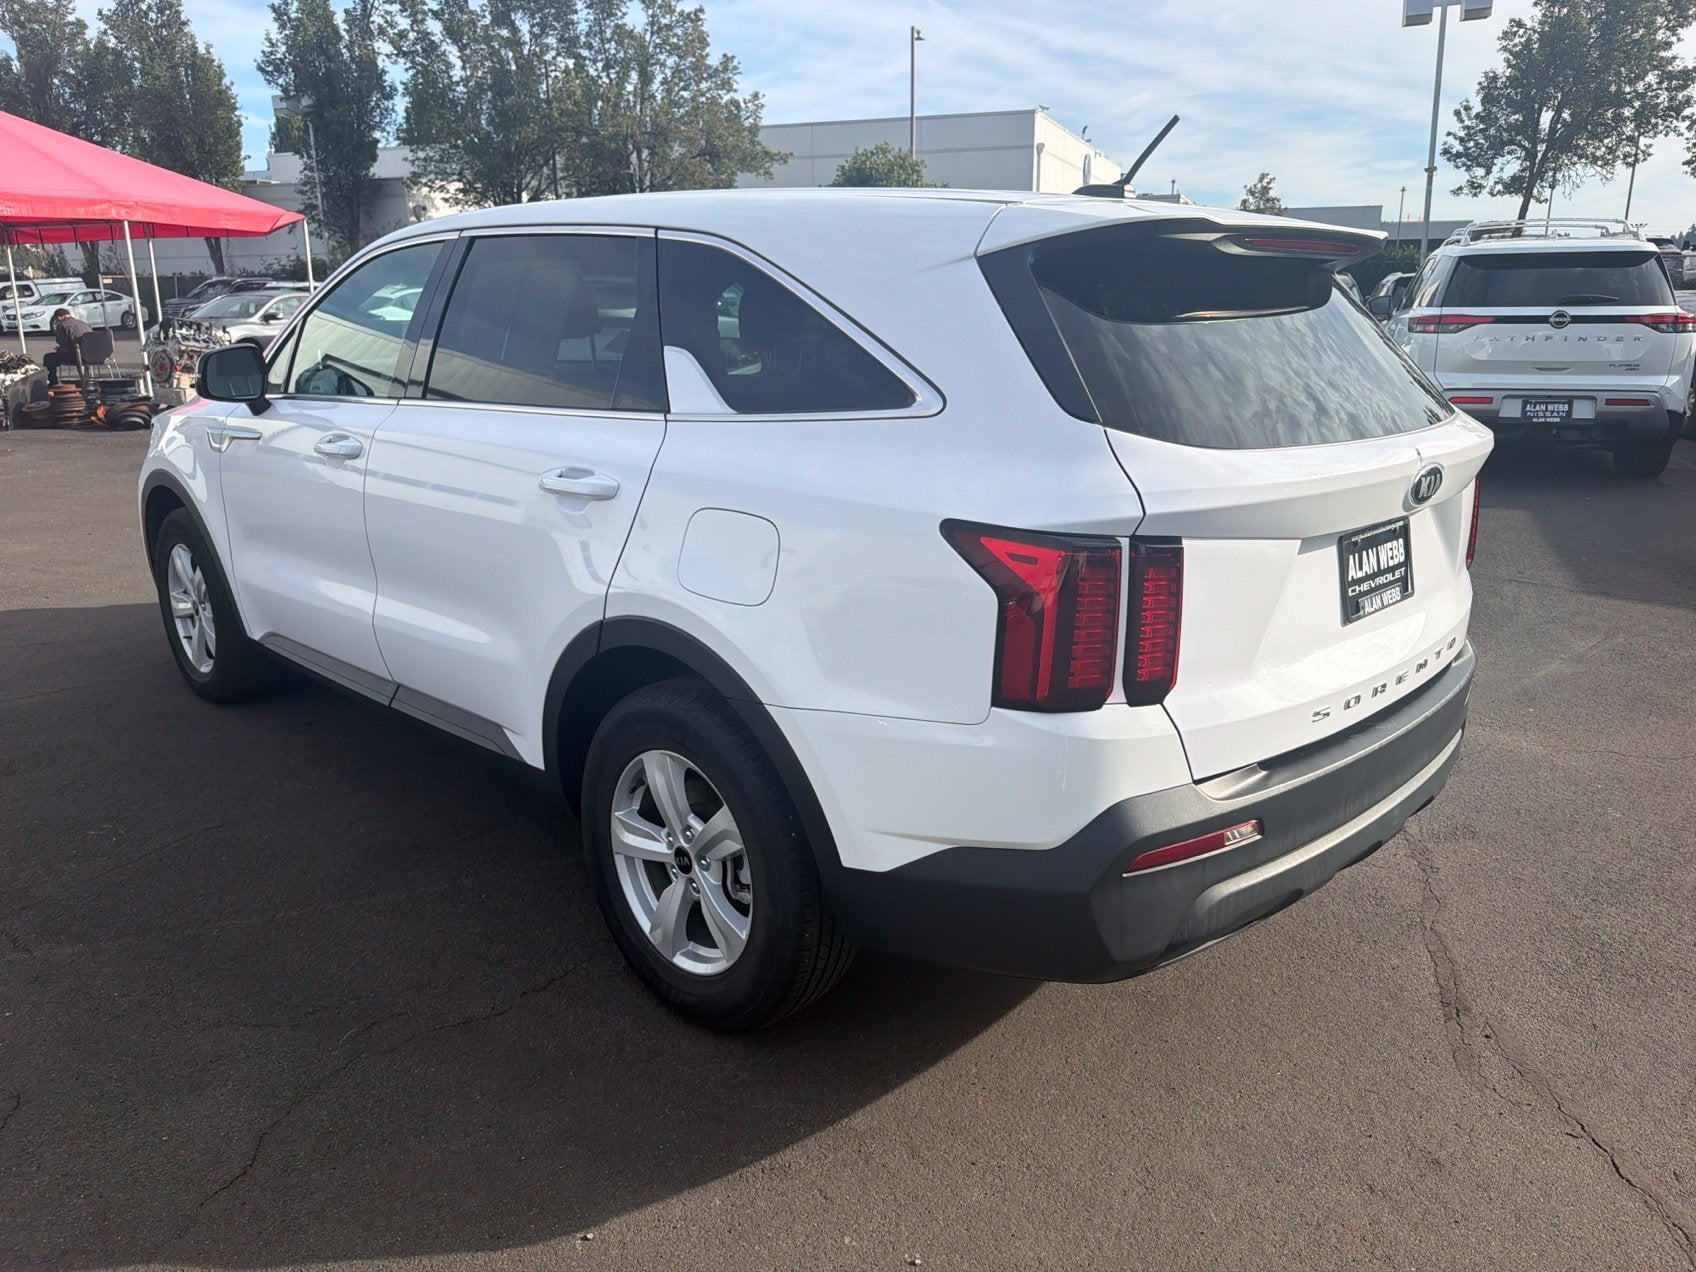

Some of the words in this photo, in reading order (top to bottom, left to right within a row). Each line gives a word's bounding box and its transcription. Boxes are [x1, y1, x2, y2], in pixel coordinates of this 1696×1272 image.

[1525, 403, 1546, 411] ALAN
[1547, 403, 1569, 411] WEBB
[1417, 473, 1440, 499] KIA
[1348, 547, 1378, 582] ALAN
[1378, 538, 1405, 570] WEBB
[1348, 567, 1406, 597] CHEVROLET
[1364, 594, 1382, 615] ALAN
[1381, 586, 1401, 607] WEBB
[1312, 636, 1456, 723] SORENTO
[675, 856, 690, 866] KIA
